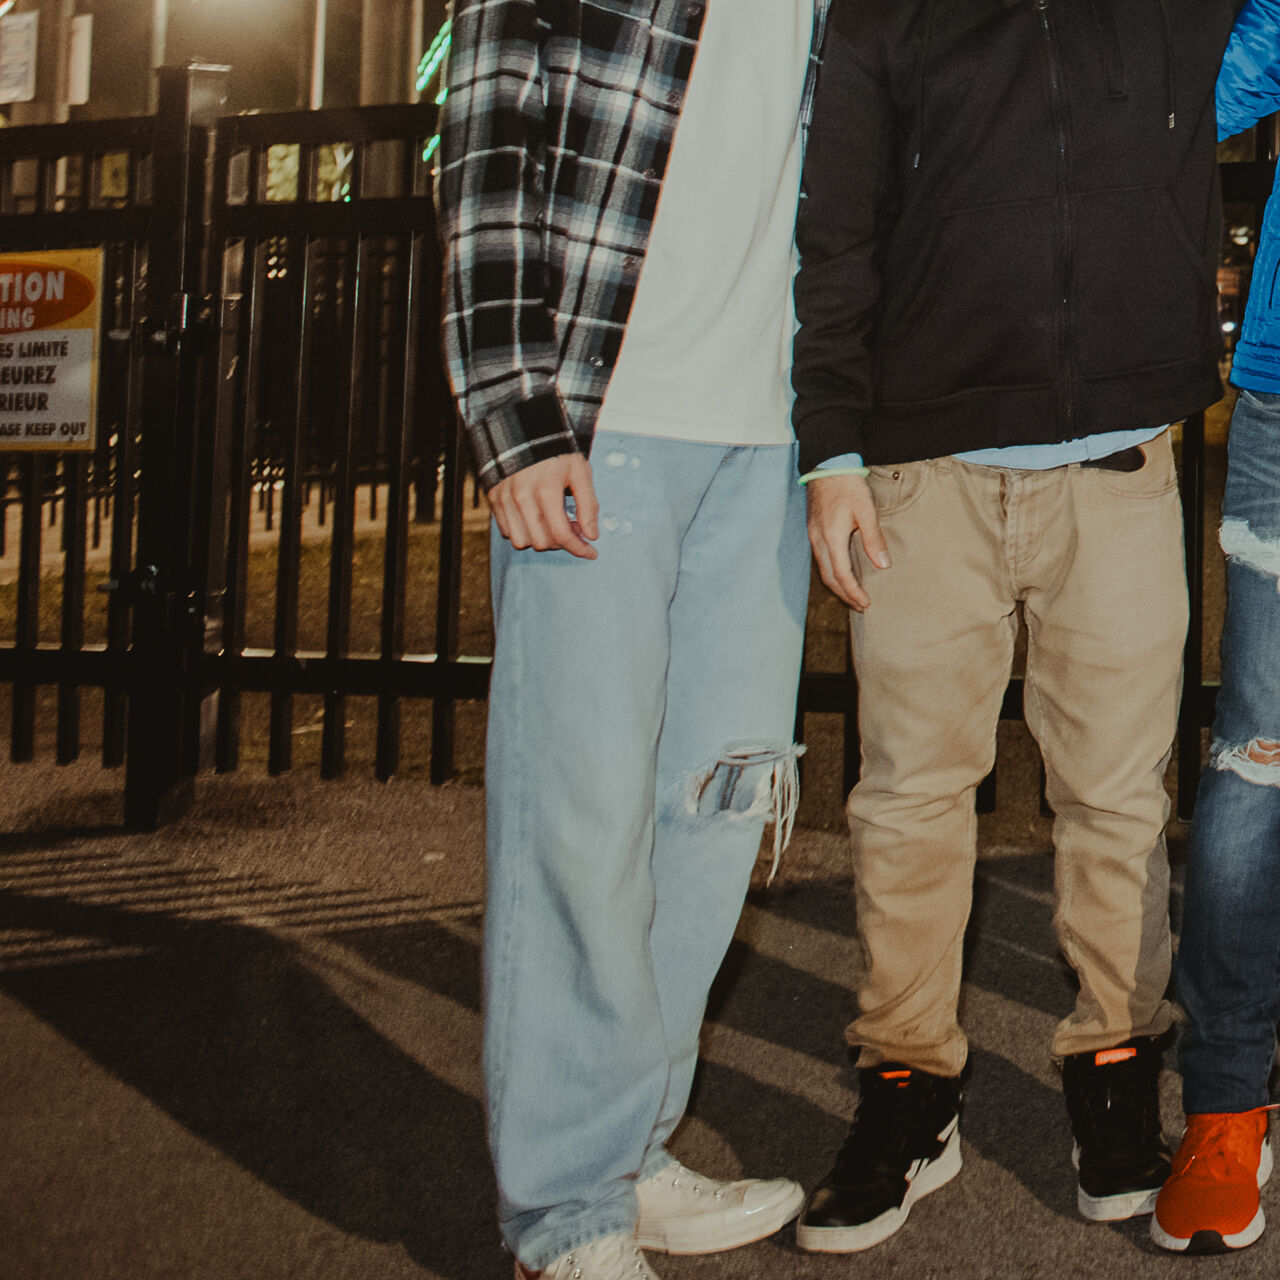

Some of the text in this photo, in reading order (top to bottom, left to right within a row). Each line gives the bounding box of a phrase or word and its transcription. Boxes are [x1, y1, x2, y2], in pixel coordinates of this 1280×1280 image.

[19, 335, 69, 358] LIMITÉ
[25, 422, 57, 436] KEEP
[60, 421, 87, 436] OUT
